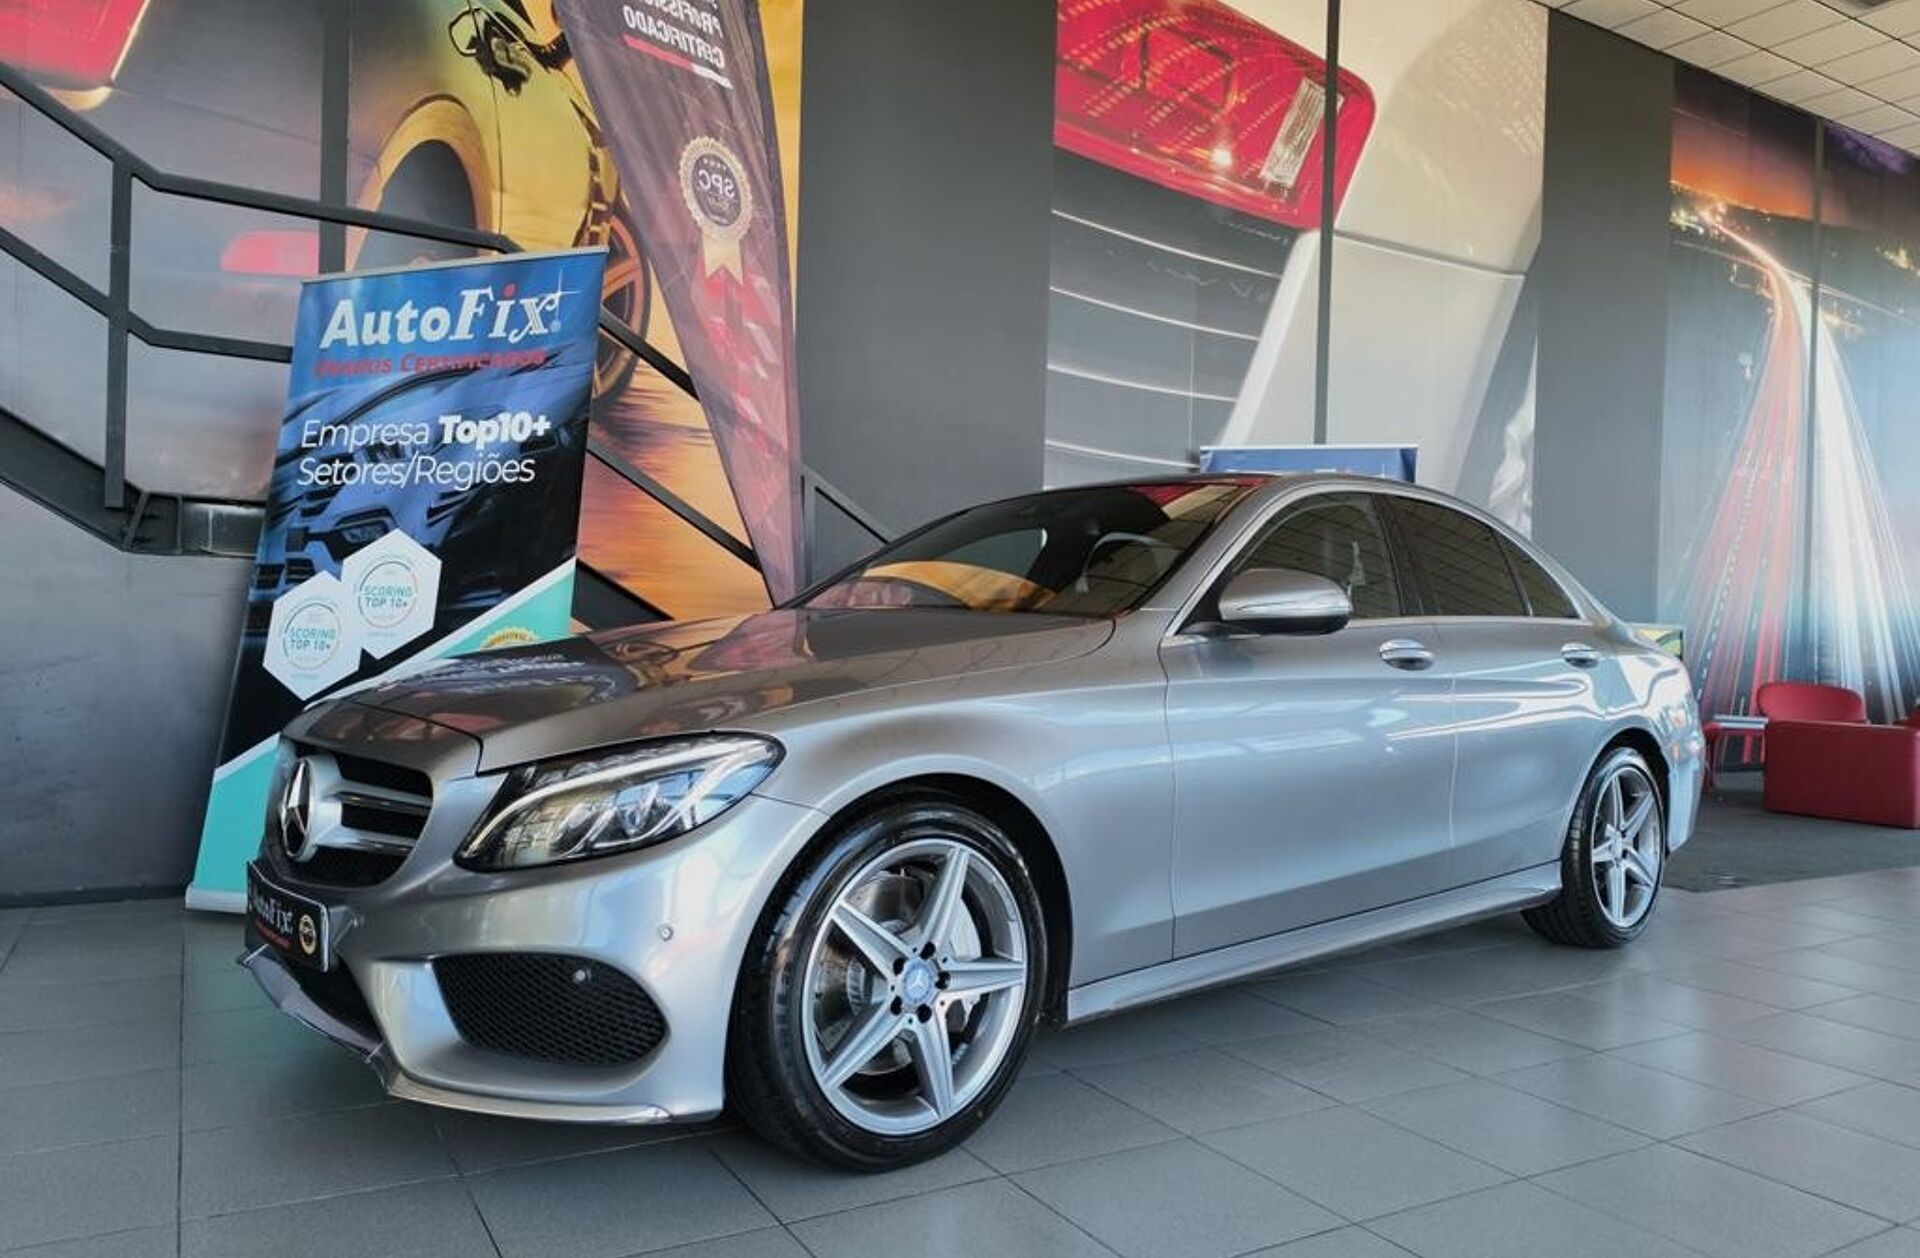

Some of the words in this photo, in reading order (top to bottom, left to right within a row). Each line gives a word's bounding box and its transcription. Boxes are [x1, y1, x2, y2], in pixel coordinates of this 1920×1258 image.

[319, 284, 560, 349] AutoFix
[300, 419, 431, 452] Empresa
[438, 411, 552, 449] Top10+
[296, 450, 536, 491] Setores/Regiões
[364, 584, 413, 598] SCORING
[365, 597, 388, 609] TOP
[289, 627, 337, 640] SCORING
[290, 639, 311, 651] TOP
